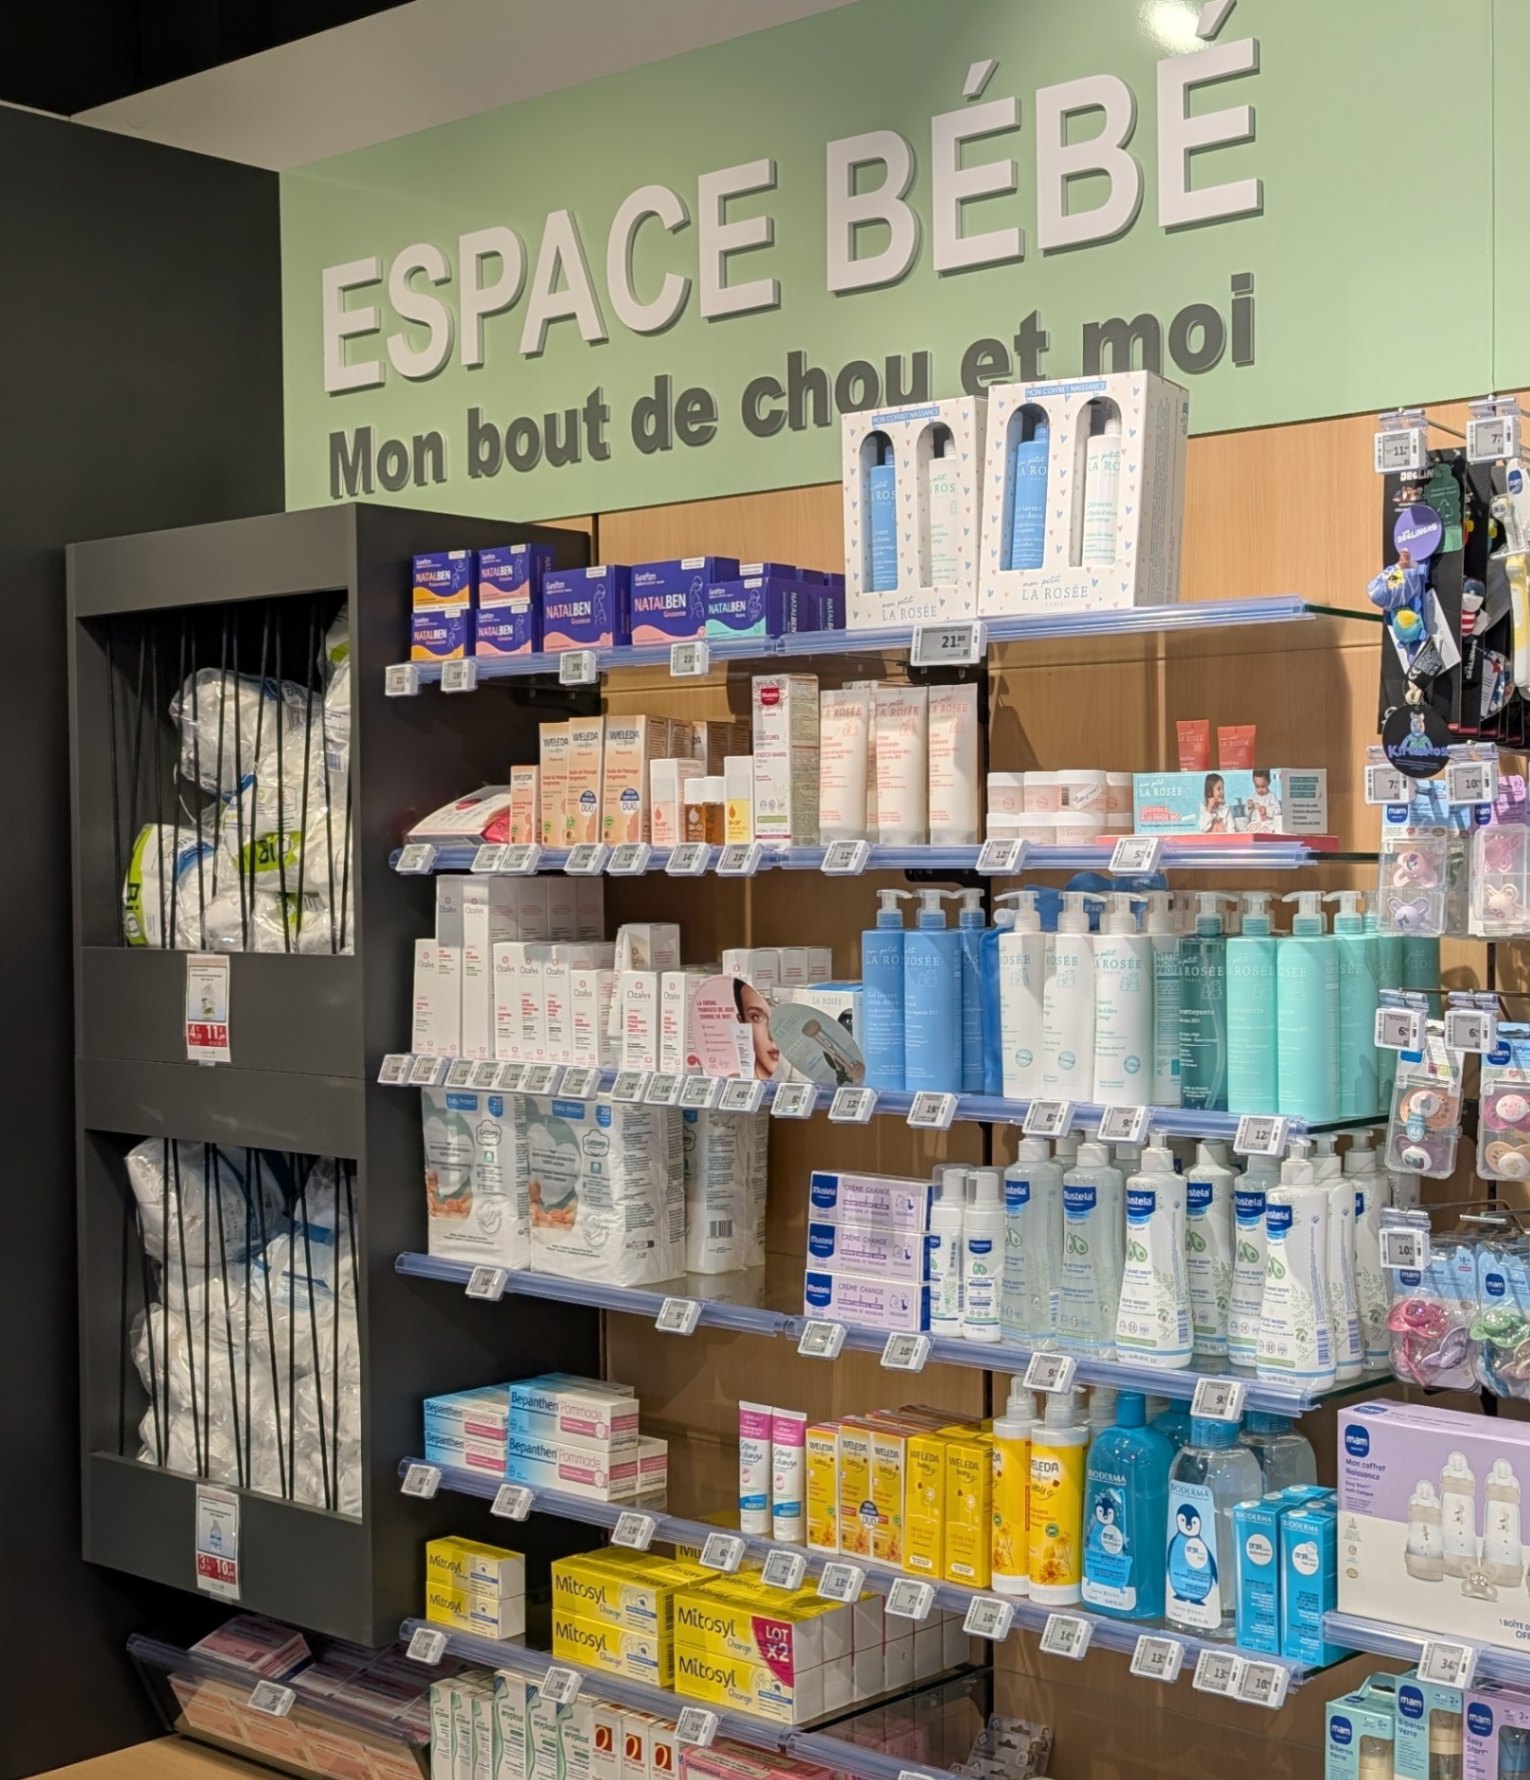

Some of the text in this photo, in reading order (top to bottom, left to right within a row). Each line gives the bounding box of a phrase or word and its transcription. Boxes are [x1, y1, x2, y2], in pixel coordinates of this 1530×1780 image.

[322, 0, 1263, 393] ESPACE BÉBÉ
[328, 272, 1254, 498] Mon bout de chou et moi
[416, 572, 450, 583] NATALBEN
[481, 566, 512, 577] NATALBEN
[1023, 585, 1088, 600] LA ROSÉE
[635, 593, 686, 612] NATALBEN
[708, 601, 745, 614] NATALBEN
[546, 602, 591, 619] NATALBEN
[882, 606, 936, 620] LA ROSÉE
[478, 625, 513, 636] NATALBEN
[573, 731, 599, 741] WELEDA
[610, 731, 639, 740] WELEDA
[544, 738, 568, 747] WELEDA
[1140, 786, 1182, 796] LA ROSÉE
[866, 1186, 890, 1195] CHANGE
[863, 1236, 887, 1244] CHANGE
[860, 1286, 884, 1295] CHANGE
[511, 1392, 602, 1419] Bepanthen Pommade
[426, 1402, 497, 1425] Bepanthen Pommade
[426, 1432, 498, 1456] Bepanthen Pommade
[809, 1442, 833, 1450] WELEDA
[842, 1439, 867, 1450] WELEDA
[1347, 1435, 1367, 1446] mam
[509, 1438, 600, 1468] Bepanthen Pommade
[910, 1451, 939, 1463] WELEDA
[949, 1457, 979, 1470] WELEDA
[1346, 1459, 1386, 1471] Mon coffret
[1089, 1470, 1126, 1483] BIODERMA
[1346, 1469, 1380, 1480] Naissance
[1171, 1483, 1209, 1498] BIODERMA
[1237, 1511, 1272, 1522] BIODERMA
[1283, 1520, 1319, 1532] BIODERMA
[429, 1554, 462, 1574] Mitosyl
[556, 1575, 606, 1603] Mitosyl
[430, 1594, 462, 1613] Mitosyl
[1503, 1618, 1523, 1629] BOÎTE
[556, 1622, 607, 1651] Mitosyl
[679, 1607, 751, 1654] Mitosyl Change
[766, 1626, 788, 1641] LOT
[767, 1644, 789, 1661] x2
[679, 1656, 752, 1704] Mitosyl Change
[1332, 1724, 1350, 1735] mam
[1399, 1728, 1417, 1737] Verre
